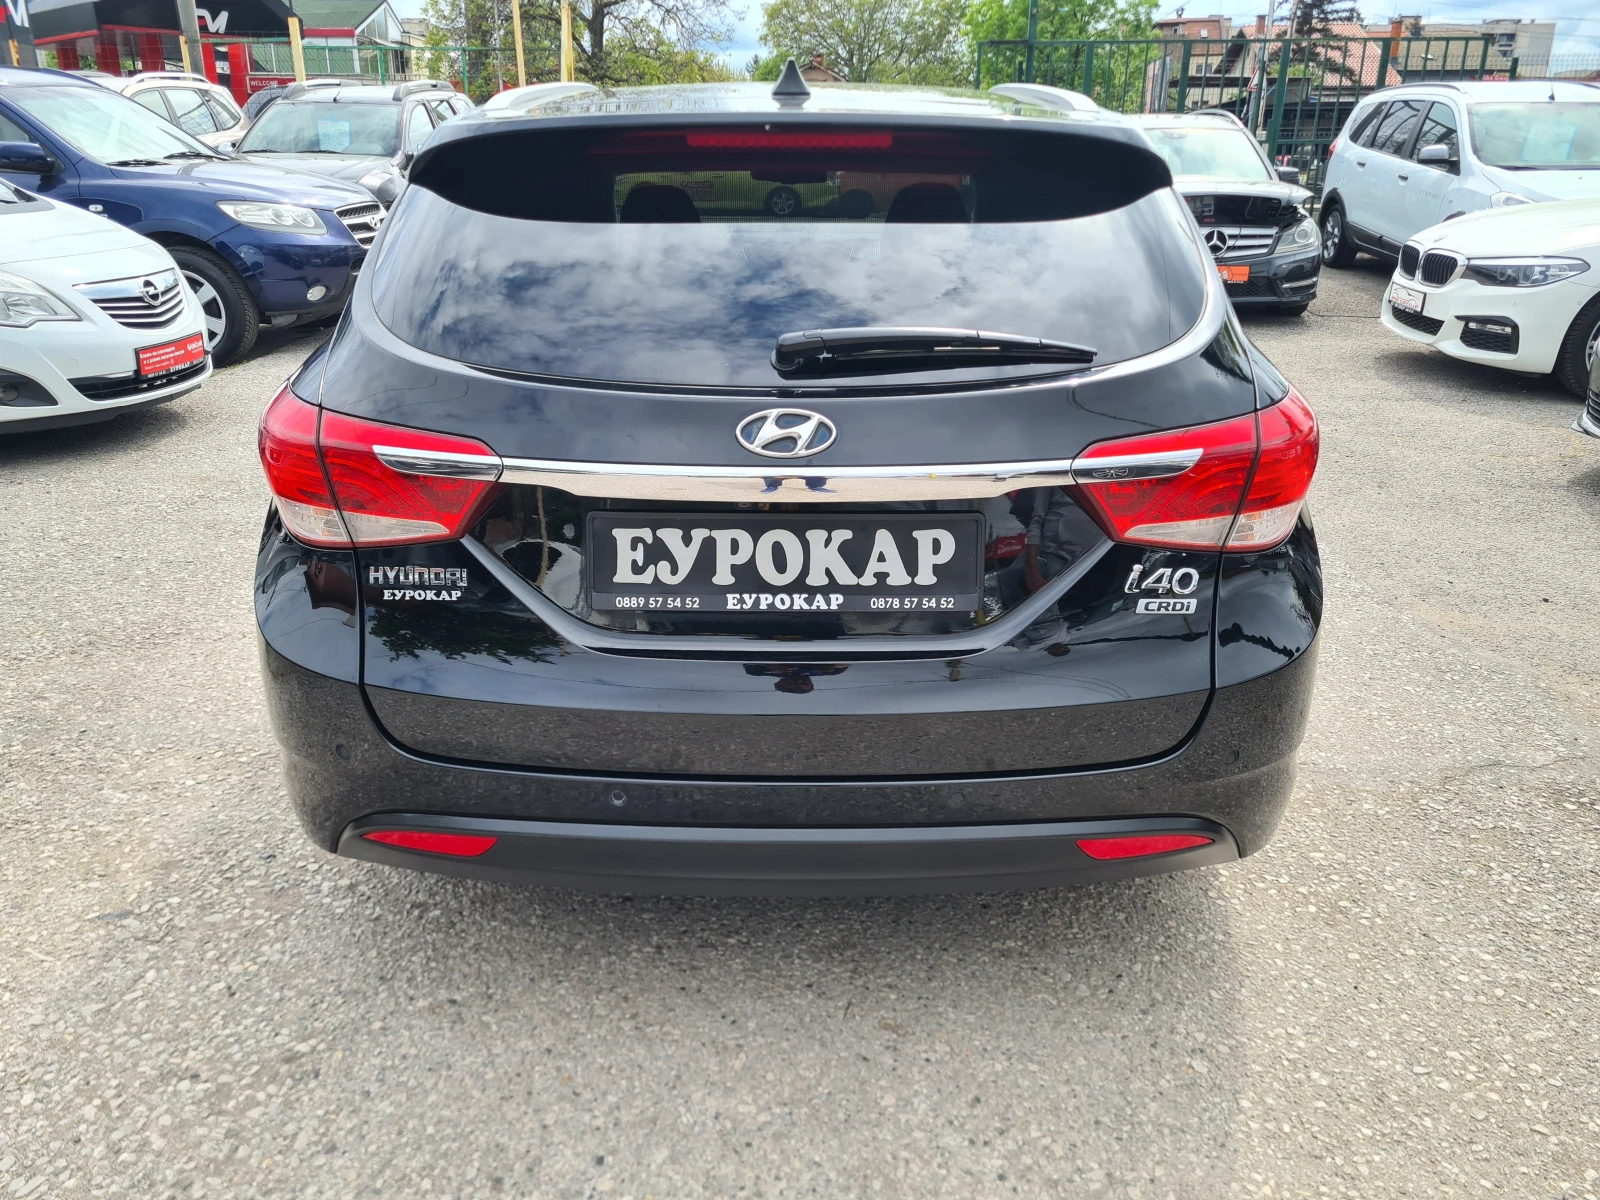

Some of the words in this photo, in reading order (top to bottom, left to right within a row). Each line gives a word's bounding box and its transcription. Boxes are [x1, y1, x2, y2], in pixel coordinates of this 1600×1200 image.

[611, 527, 956, 586] ЕУРОКАР
[369, 565, 468, 587] HYUNDAI
[1124, 564, 1200, 595] i40
[382, 589, 462, 600] ЕУРОКАР
[615, 597, 645, 608] 0889
[648, 597, 663, 608] 57
[666, 597, 682, 608] 54
[685, 597, 700, 608] 52
[725, 593, 844, 610] ЕУРОКАР
[870, 598, 900, 609] 0878
[903, 598, 918, 609] 57
[921, 598, 937, 609] 54
[939, 598, 955, 609] 52
[1144, 601, 1191, 612] CRDi
